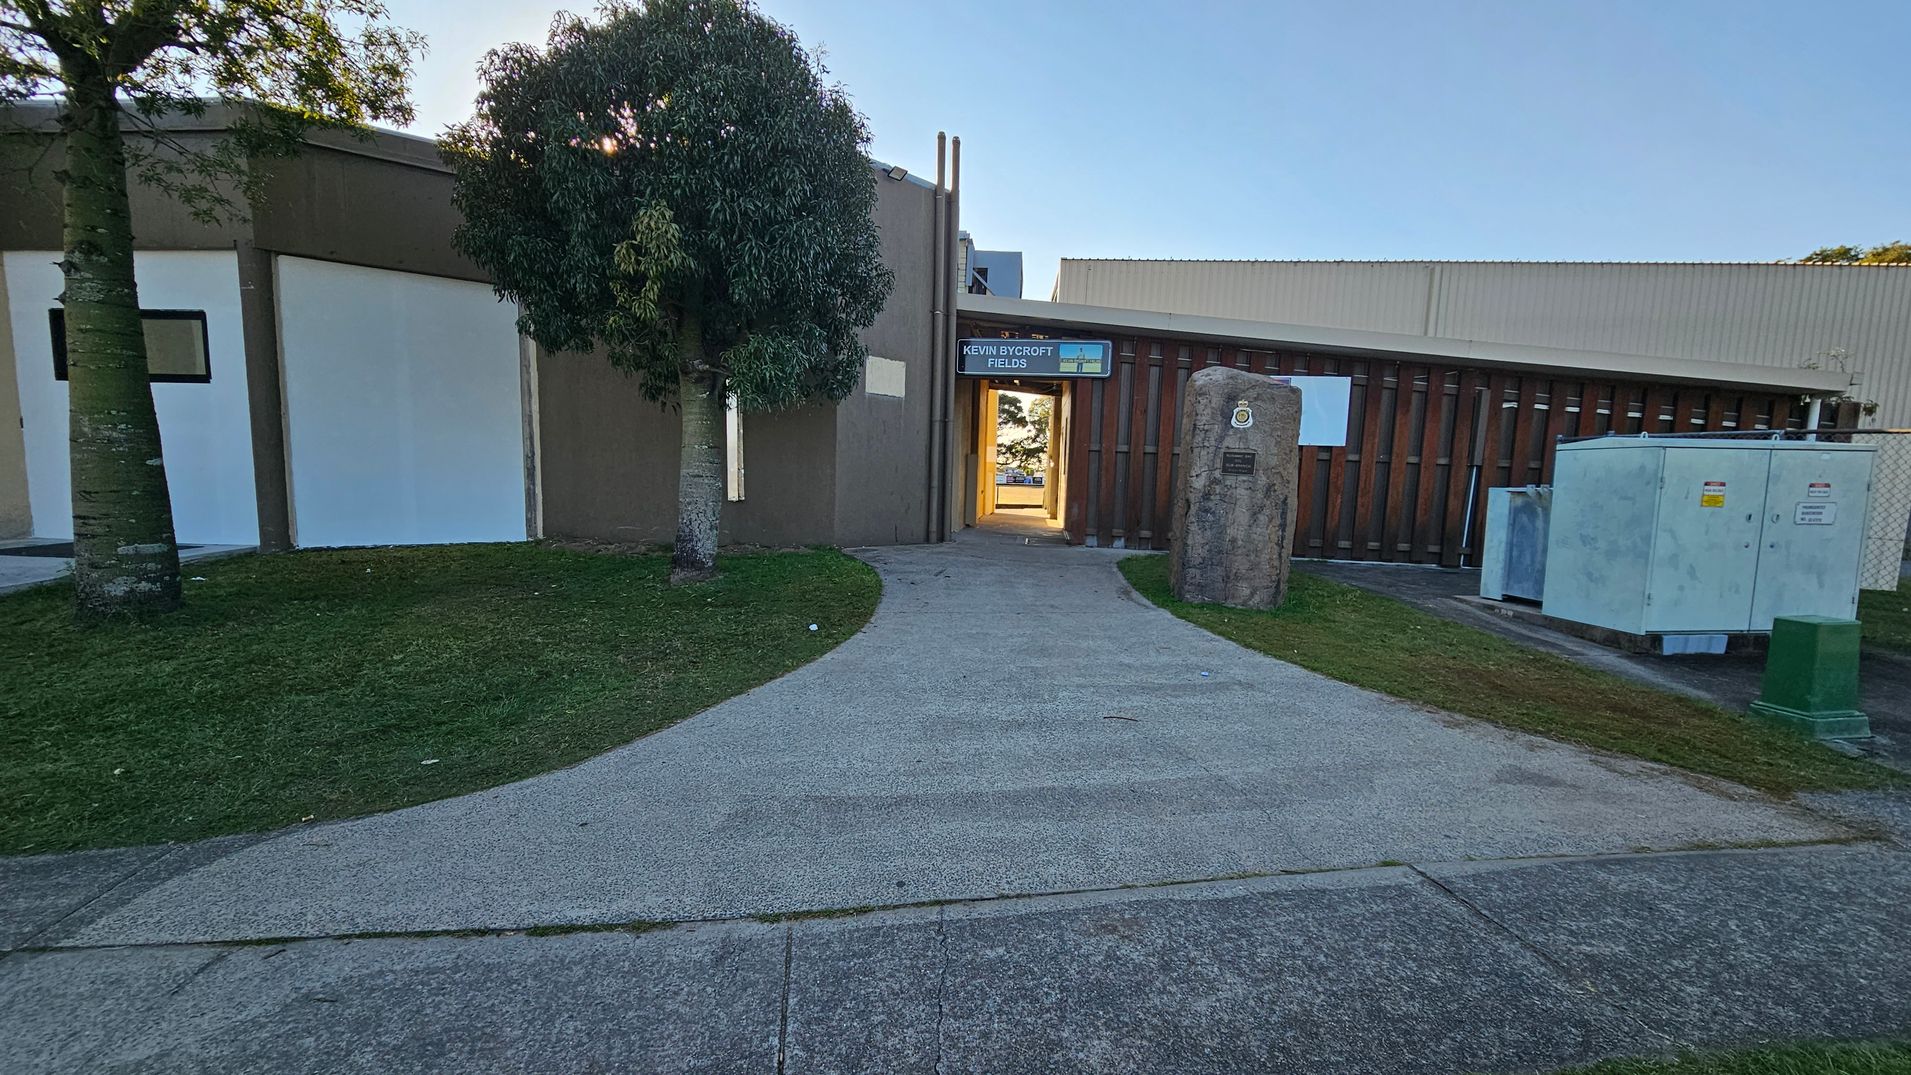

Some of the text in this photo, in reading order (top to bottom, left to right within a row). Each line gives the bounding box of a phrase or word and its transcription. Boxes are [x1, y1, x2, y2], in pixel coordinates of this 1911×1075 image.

[963, 345, 1054, 356] KEVIN BYCROFT
[988, 358, 1027, 368] FIELDS
